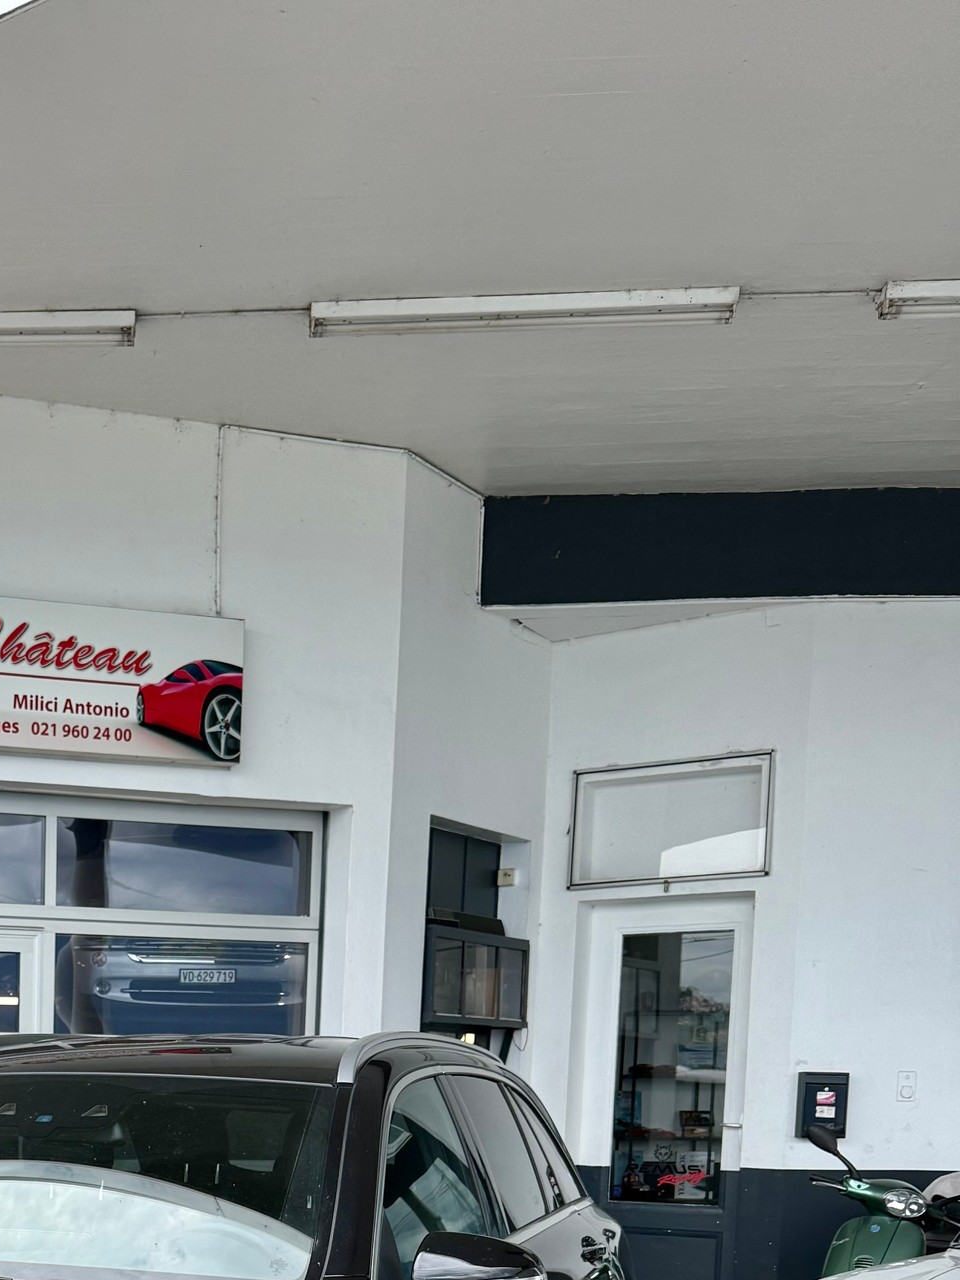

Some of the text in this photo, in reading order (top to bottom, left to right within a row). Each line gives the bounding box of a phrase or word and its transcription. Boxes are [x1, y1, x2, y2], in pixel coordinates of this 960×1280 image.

[12, 693, 130, 719] Milici Antonio
[31, 722, 132, 743] 021 960 24 00
[624, 1163, 702, 1175] REMUS
